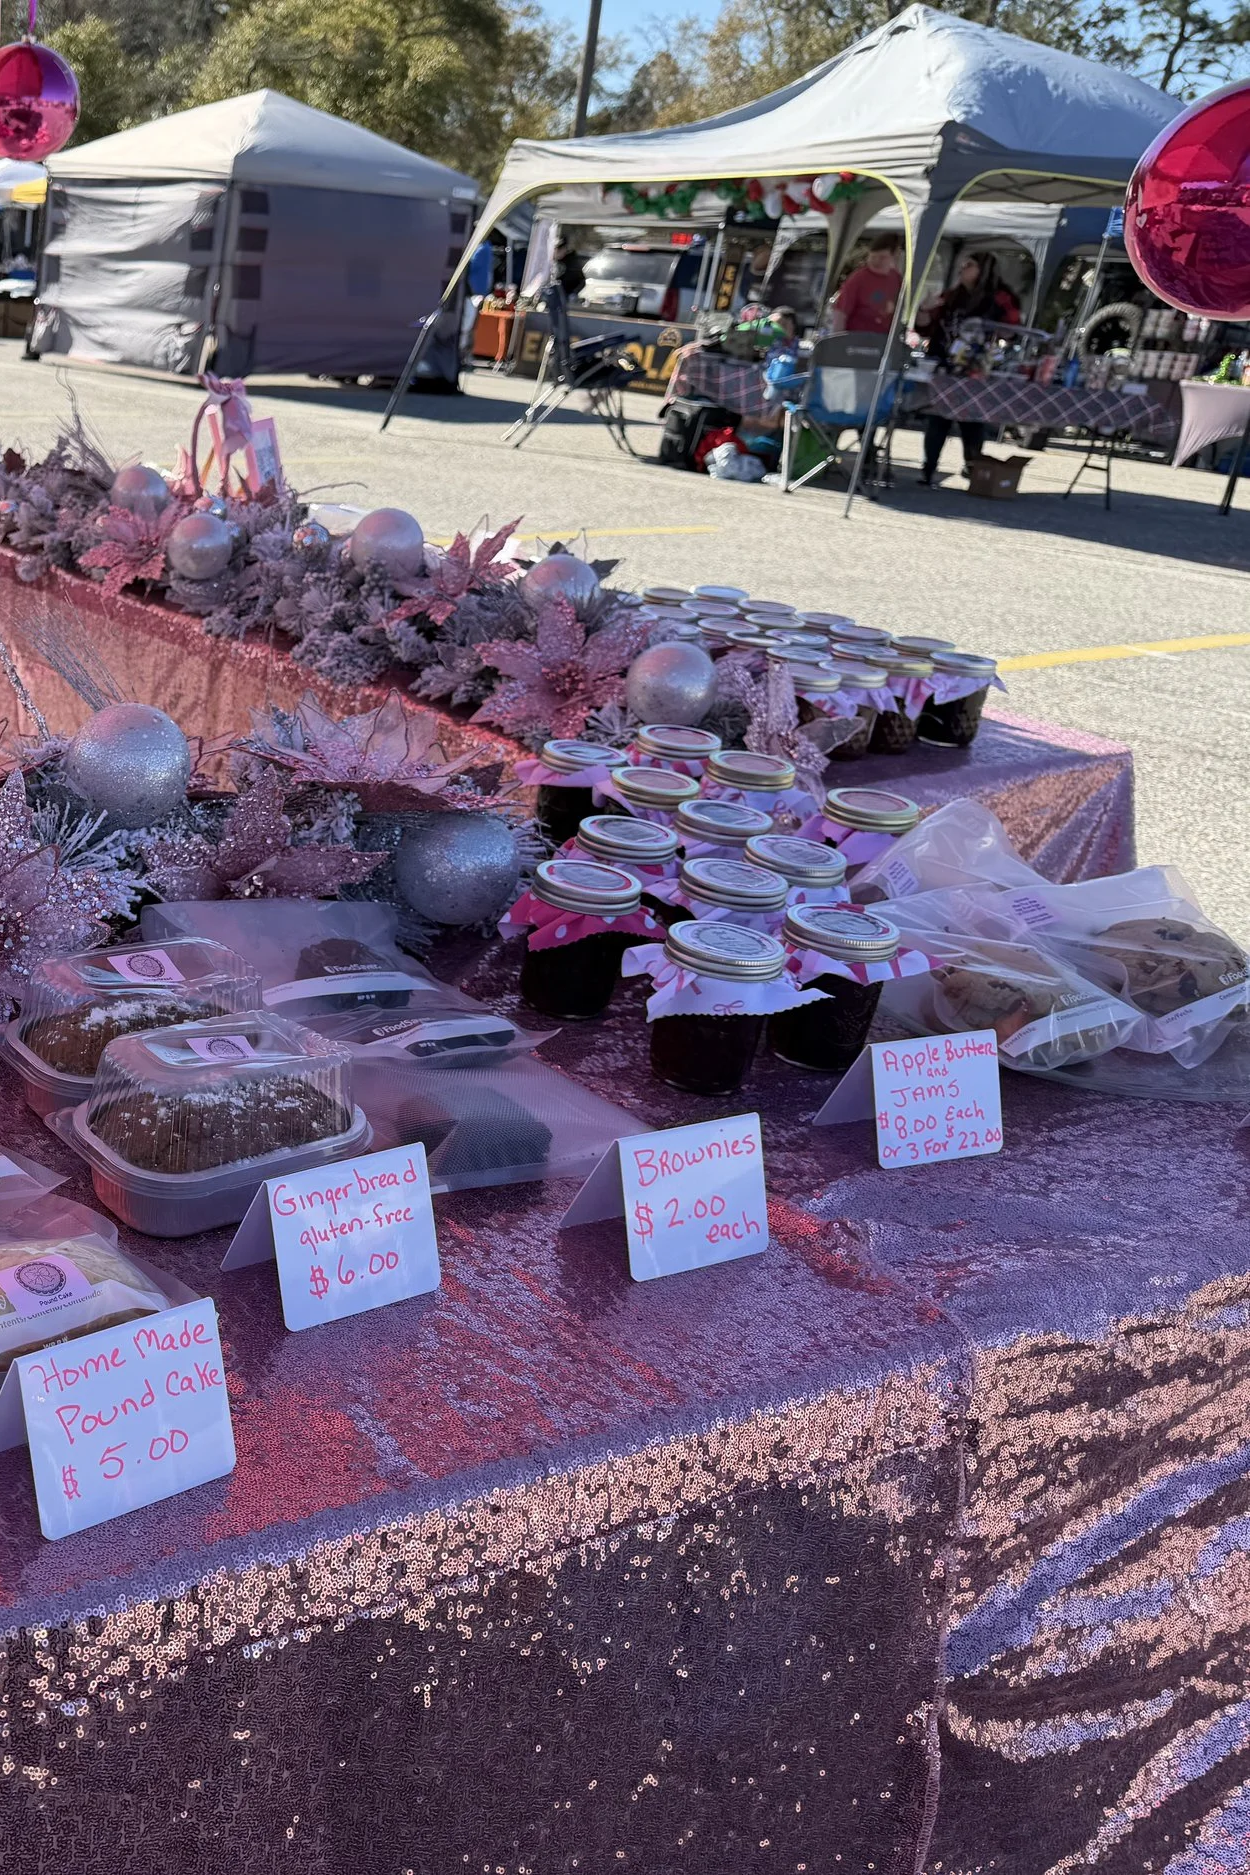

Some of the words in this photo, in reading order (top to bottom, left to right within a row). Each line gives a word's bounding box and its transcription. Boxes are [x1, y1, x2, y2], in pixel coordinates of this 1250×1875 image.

[882, 1043, 940, 1076] Apple
[926, 1063, 950, 1078] and
[906, 1142, 920, 1160] 3
[299, 1203, 415, 1256] gluten-free
[705, 1210, 761, 1245] each
[39, 1297, 59, 1307] Pound
[58, 1290, 74, 1300] Cake
[28, 1345, 126, 1394] Home
[134, 1319, 213, 1360] Made
[56, 1377, 155, 1445] Pound
